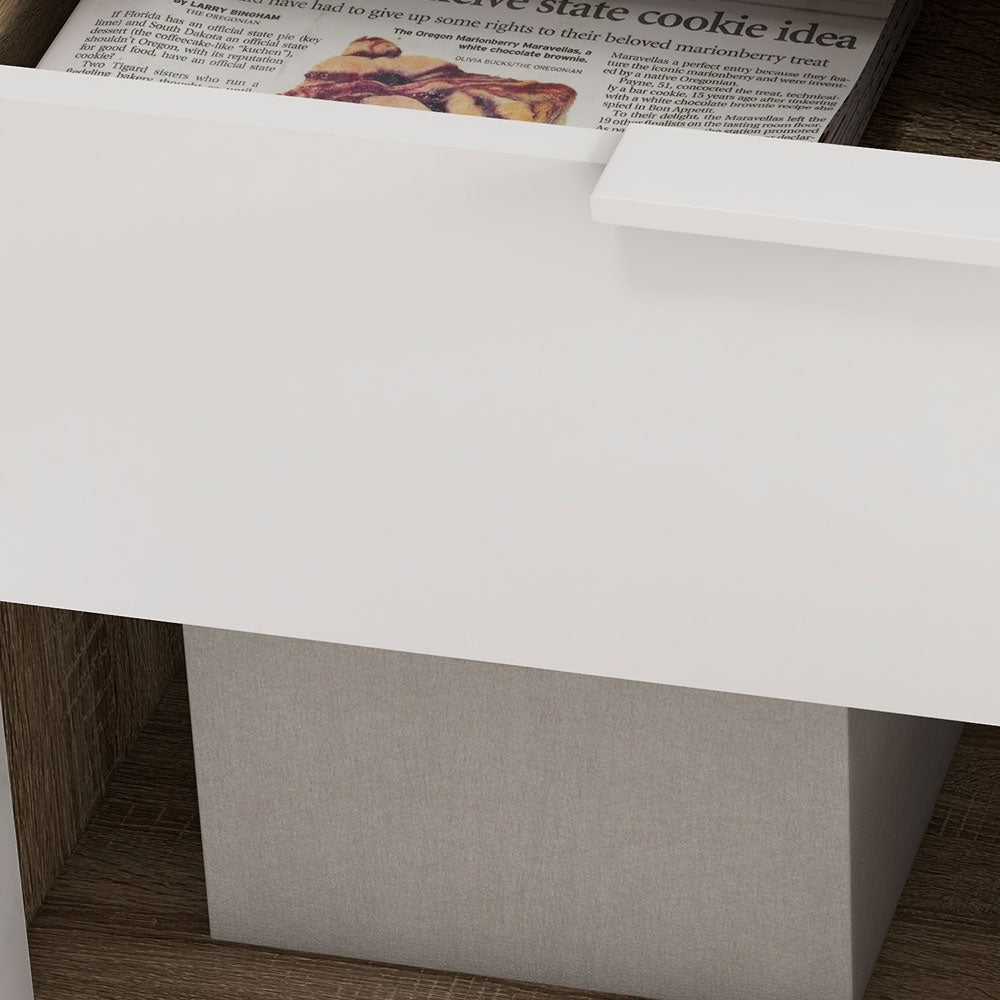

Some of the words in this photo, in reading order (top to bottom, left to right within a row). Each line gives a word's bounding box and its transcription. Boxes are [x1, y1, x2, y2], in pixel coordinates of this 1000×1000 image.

[186, 8, 203, 18] THE
[205, 11, 261, 25] OREGONIAN
[190, 0, 228, 14] LARRY
[229, 9, 282, 21] BINGHAM
[90, 26, 127, 36] dessert
[130, 27, 152, 38] (the
[154, 32, 235, 52] coffeecake-like
[94, 18, 123, 28] lime)
[124, 18, 147, 28] and
[149, 21, 180, 34] South
[184, 28, 223, 42] Dakota
[226, 36, 240, 44] an
[242, 37, 280, 49] official
[282, 42, 309, 52] state
[111, 10, 124, 18] If
[122, 10, 162, 21] Florida
[165, 14, 185, 24] has
[189, 20, 203, 28] an
[206, 22, 243, 36] official
[248, 29, 274, 40] state
[277, 32, 296, 43] pie
[298, 34, 322, 45] (key
[311, 0, 347, 14] had
[348, 4, 366, 16] to
[368, 5, 405, 21] give
[408, 12, 431, 25] up
[434, 14, 481, 29] some
[485, 18, 535, 37] rights
[538, 24, 556, 37] to
[560, 26, 602, 42] their
[605, 31, 673, 51] beloved
[675, 41, 789, 66] marionberry
[790, 54, 832, 68] treat
[637, 11, 768, 39] cookie
[773, 20, 859, 51] idea
[74, 51, 116, 61] cookie?
[138, 36, 180, 53] Oregon,
[184, 46, 209, 57] with
[211, 49, 224, 59] its
[226, 52, 284, 66] reputation
[394, 28, 412, 37] The
[415, 30, 454, 42] Oregon
[455, 34, 520, 50] Marionberry
[522, 42, 582, 57] Maravellas,
[458, 43, 488, 54] white
[489, 46, 542, 60] chocolate
[544, 53, 588, 64] brownie.
[80, 43, 97, 51] for
[98, 44, 128, 54] good
[129, 46, 157, 58] food,
[160, 52, 187, 63] have
[190, 57, 206, 66] an
[208, 58, 246, 71] official
[249, 64, 276, 73] state
[455, 55, 483, 64] OLIVIA
[533, 64, 583, 75] OREGONIAN
[610, 52, 670, 66] Maravellas
[682, 60, 721, 72] perfect
[724, 65, 754, 77] entry
[755, 68, 801, 78] because
[802, 71, 828, 83] they
[82, 60, 106, 70] Two
[112, 61, 150, 74] Tigard
[152, 68, 190, 80] sisters
[195, 74, 220, 84] who
[225, 79, 247, 87] run
